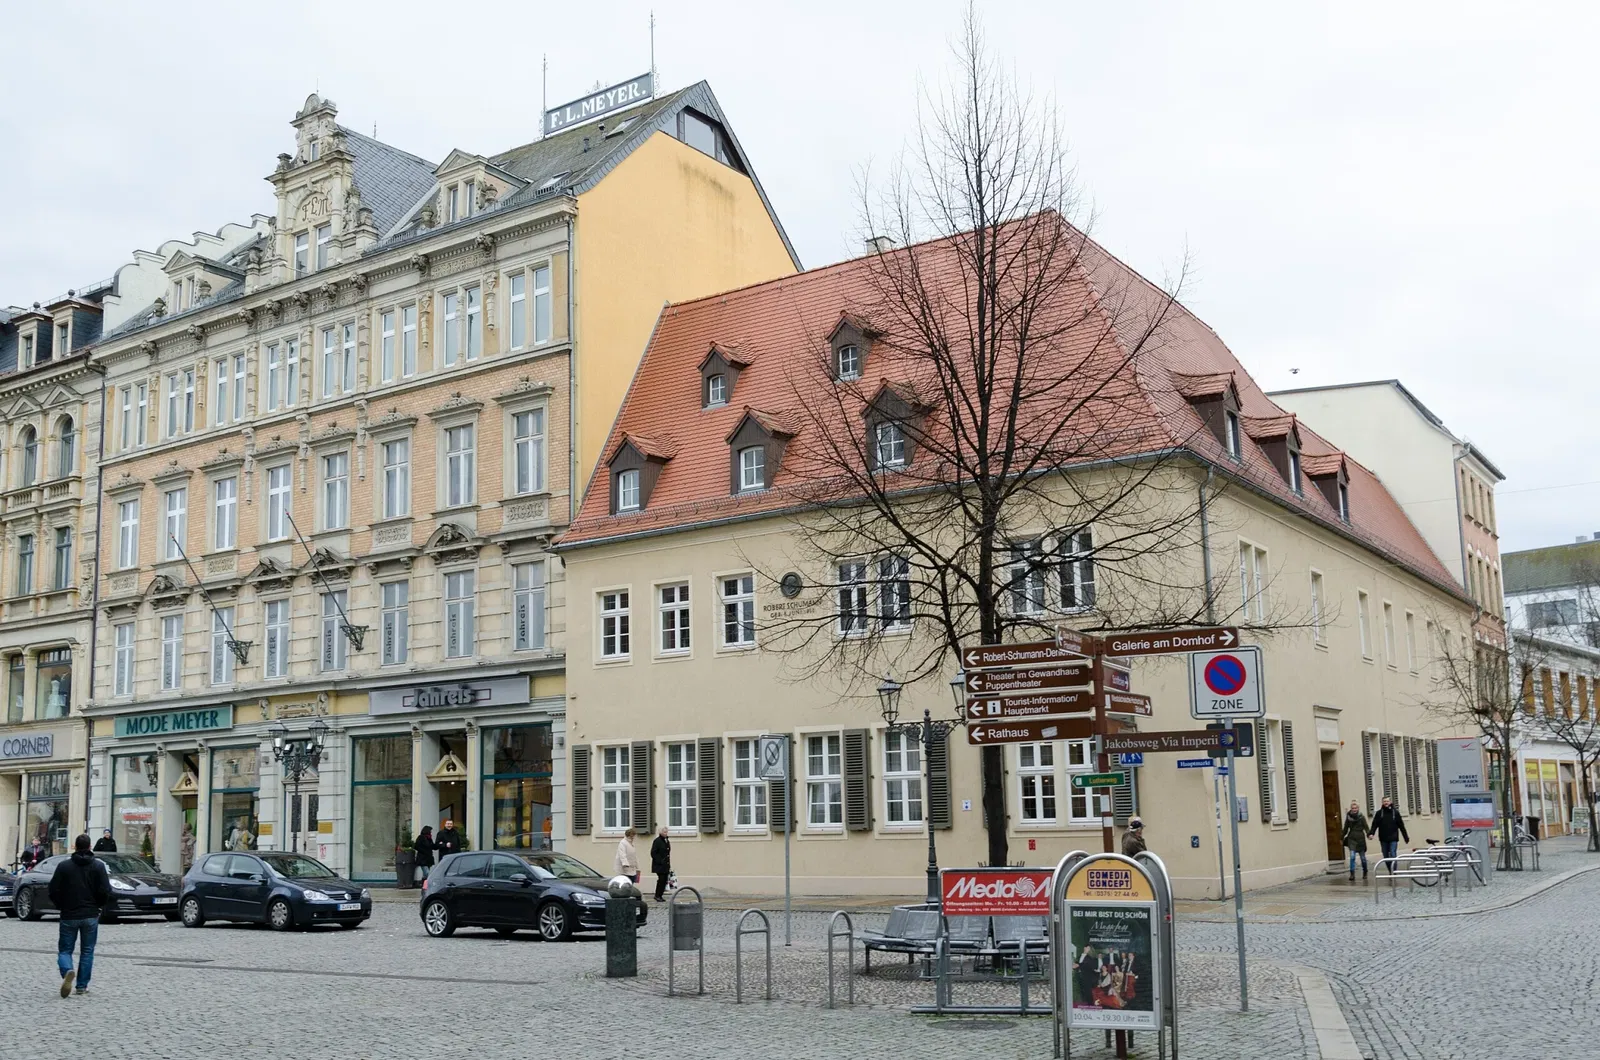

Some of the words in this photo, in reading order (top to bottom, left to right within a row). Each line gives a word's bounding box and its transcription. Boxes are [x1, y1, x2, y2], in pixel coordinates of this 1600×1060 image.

[1112, 639, 1150, 651] Galerie
[1153, 640, 1170, 648] am
[1173, 634, 1216, 647] Domhof
[983, 647, 1073, 662] Robert-Schumann-Den
[986, 671, 1015, 681] Theater
[1017, 671, 1026, 679] im
[1028, 668, 1080, 678] Gewandhaus
[985, 680, 1042, 691] Puppentheater
[411, 685, 474, 708] Jahreis
[1004, 694, 1079, 706] Tourist-Information/
[1211, 699, 1244, 710] ZONE
[1004, 705, 1049, 716] Hauptmarkt
[126, 714, 168, 735] MODE
[172, 710, 219, 731] MEYER
[988, 728, 1030, 739] Rathaus
[3, 736, 50, 757] CORNER
[1105, 738, 1159, 750] Jakobsweg
[1161, 737, 1179, 747] Via
[1182, 735, 1219, 748] Imperii
[1180, 760, 1211, 768] Hauptmarkt
[1089, 871, 1129, 880] COMEDIA
[1089, 879, 1129, 888] CONCEPT
[1085, 910, 1097, 918] MIR
[1125, 910, 1148, 919] SCHÖN
[1102, 1014, 1121, 1022] 19.30
[1122, 1014, 1136, 1022] Uhr
